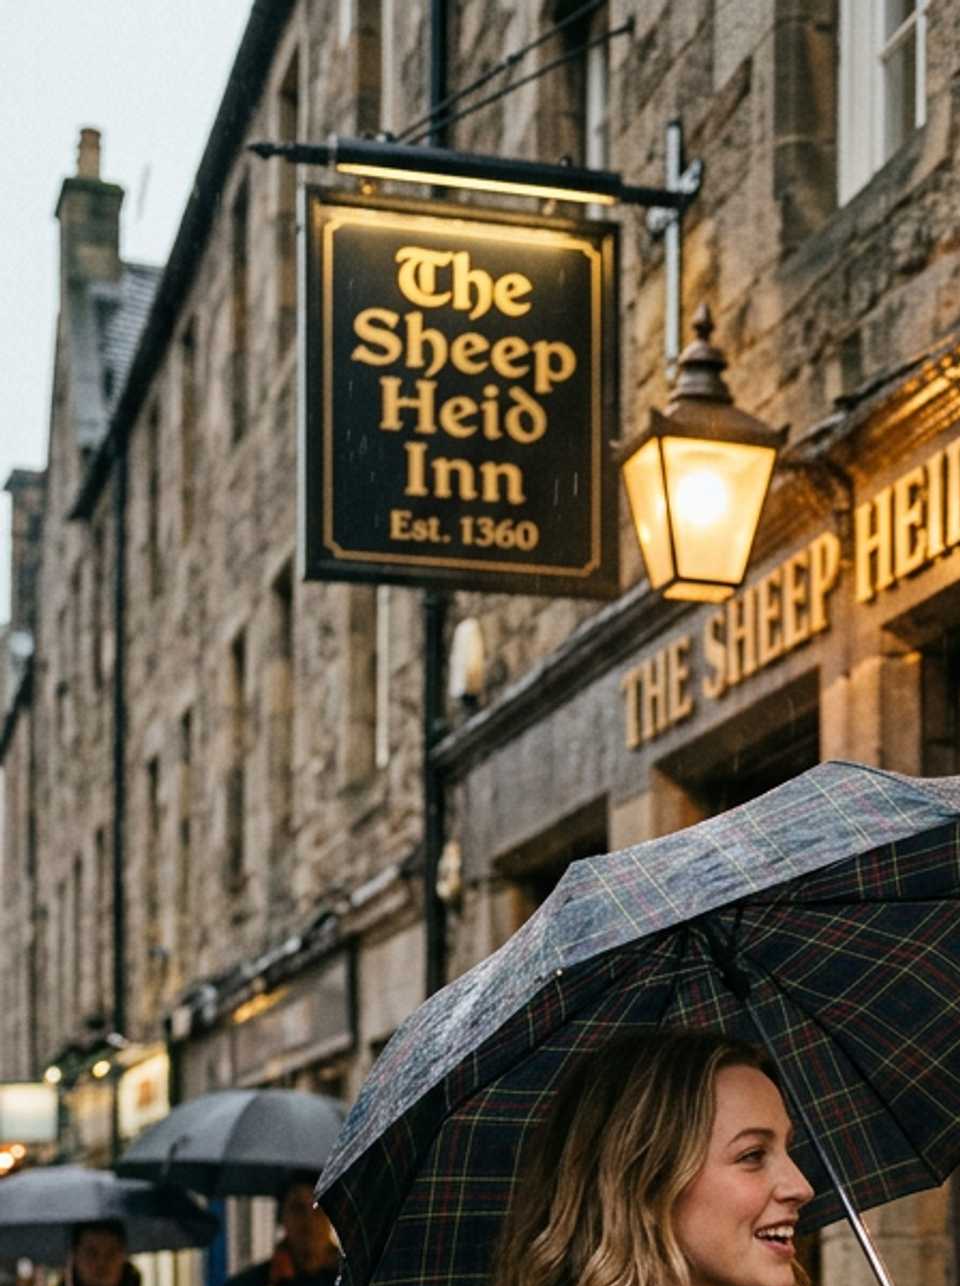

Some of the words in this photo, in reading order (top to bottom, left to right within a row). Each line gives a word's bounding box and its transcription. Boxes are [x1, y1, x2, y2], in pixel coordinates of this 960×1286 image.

[396, 247, 532, 320] The
[352, 308, 576, 394] Sheep
[380, 377, 548, 443] Heid
[405, 442, 525, 504] Inn
[390, 511, 450, 543] Est.
[460, 516, 539, 550] 1360
[621, 637, 694, 748] THE
[704, 532, 841, 701] SHEEP
